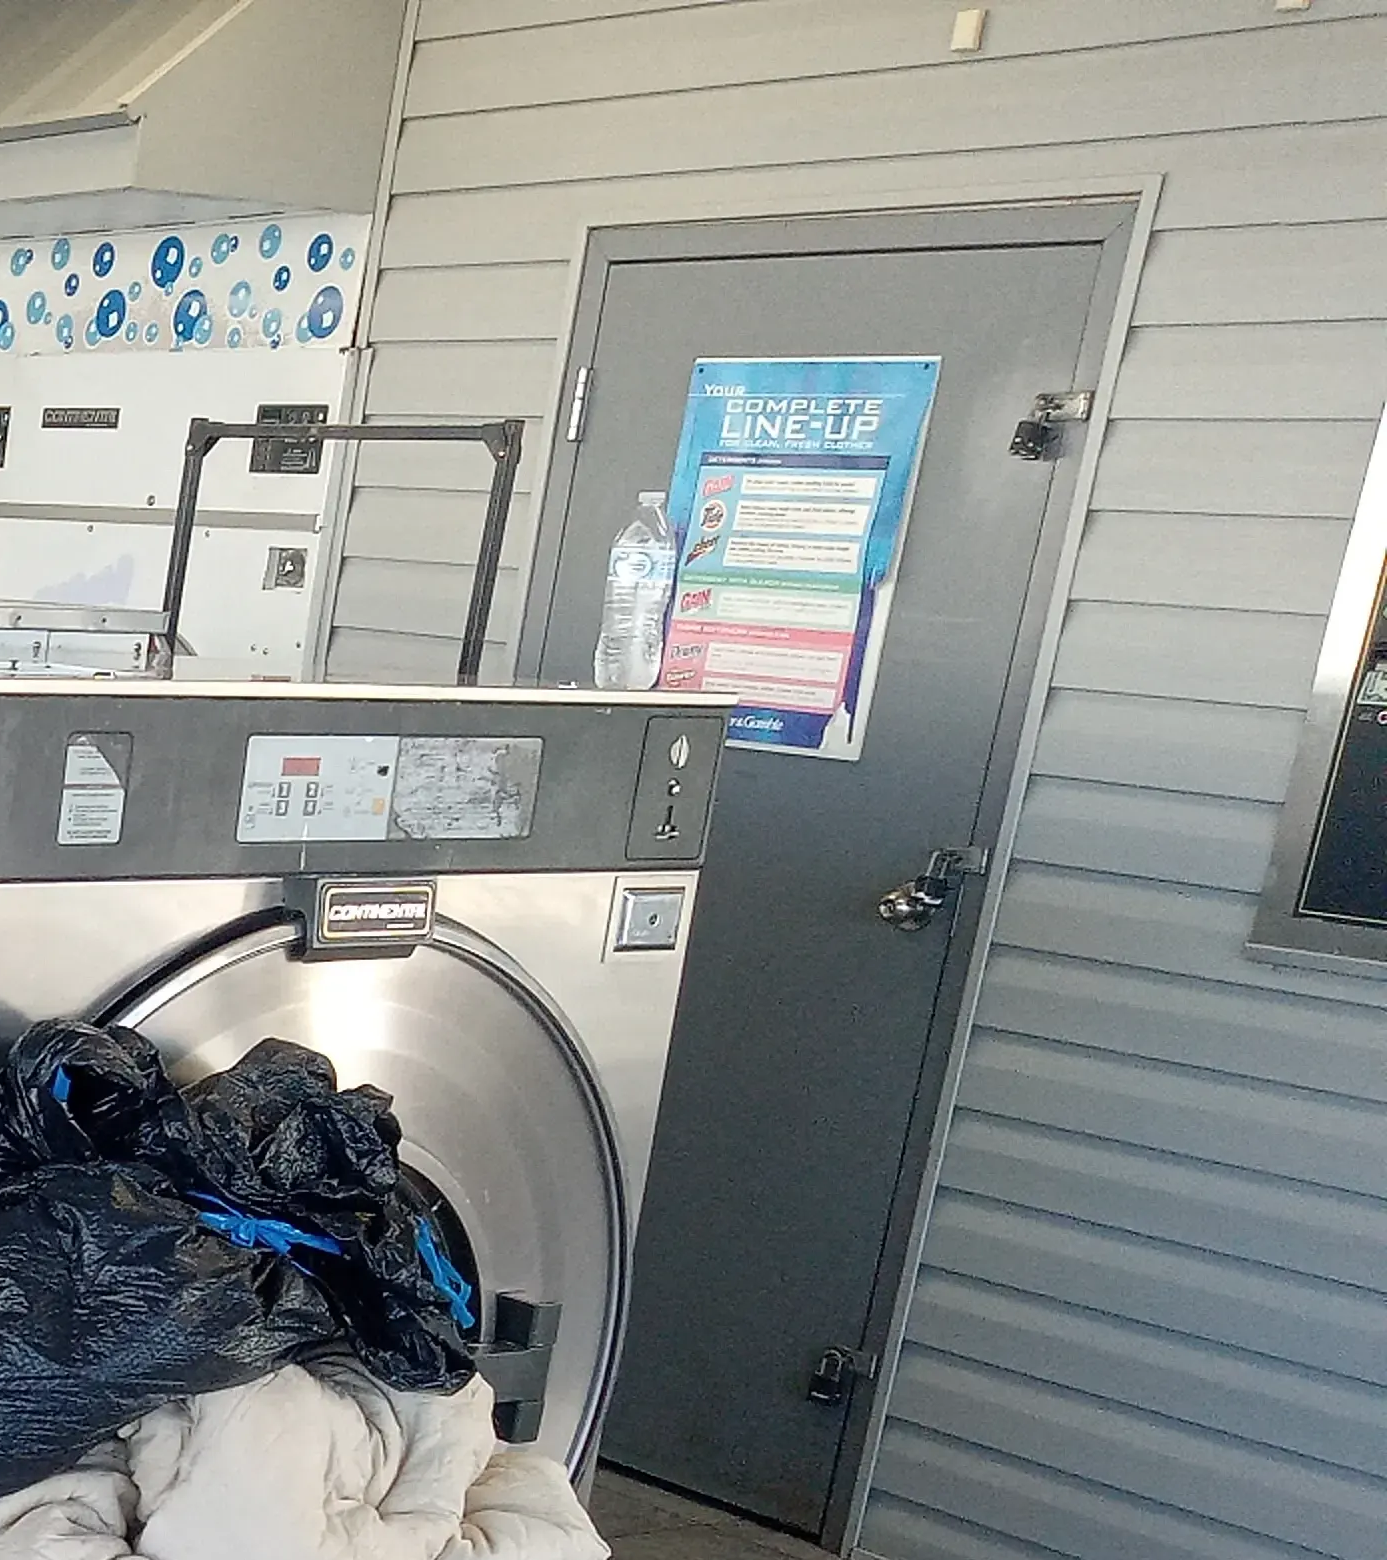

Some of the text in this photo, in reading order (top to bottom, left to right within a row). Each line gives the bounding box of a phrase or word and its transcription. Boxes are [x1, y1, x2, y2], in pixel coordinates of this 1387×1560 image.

[703, 383, 746, 397] YOUR
[726, 399, 883, 415] COMPLETE
[720, 414, 880, 441] LINE-UP
[784, 440, 820, 449] FRESH
